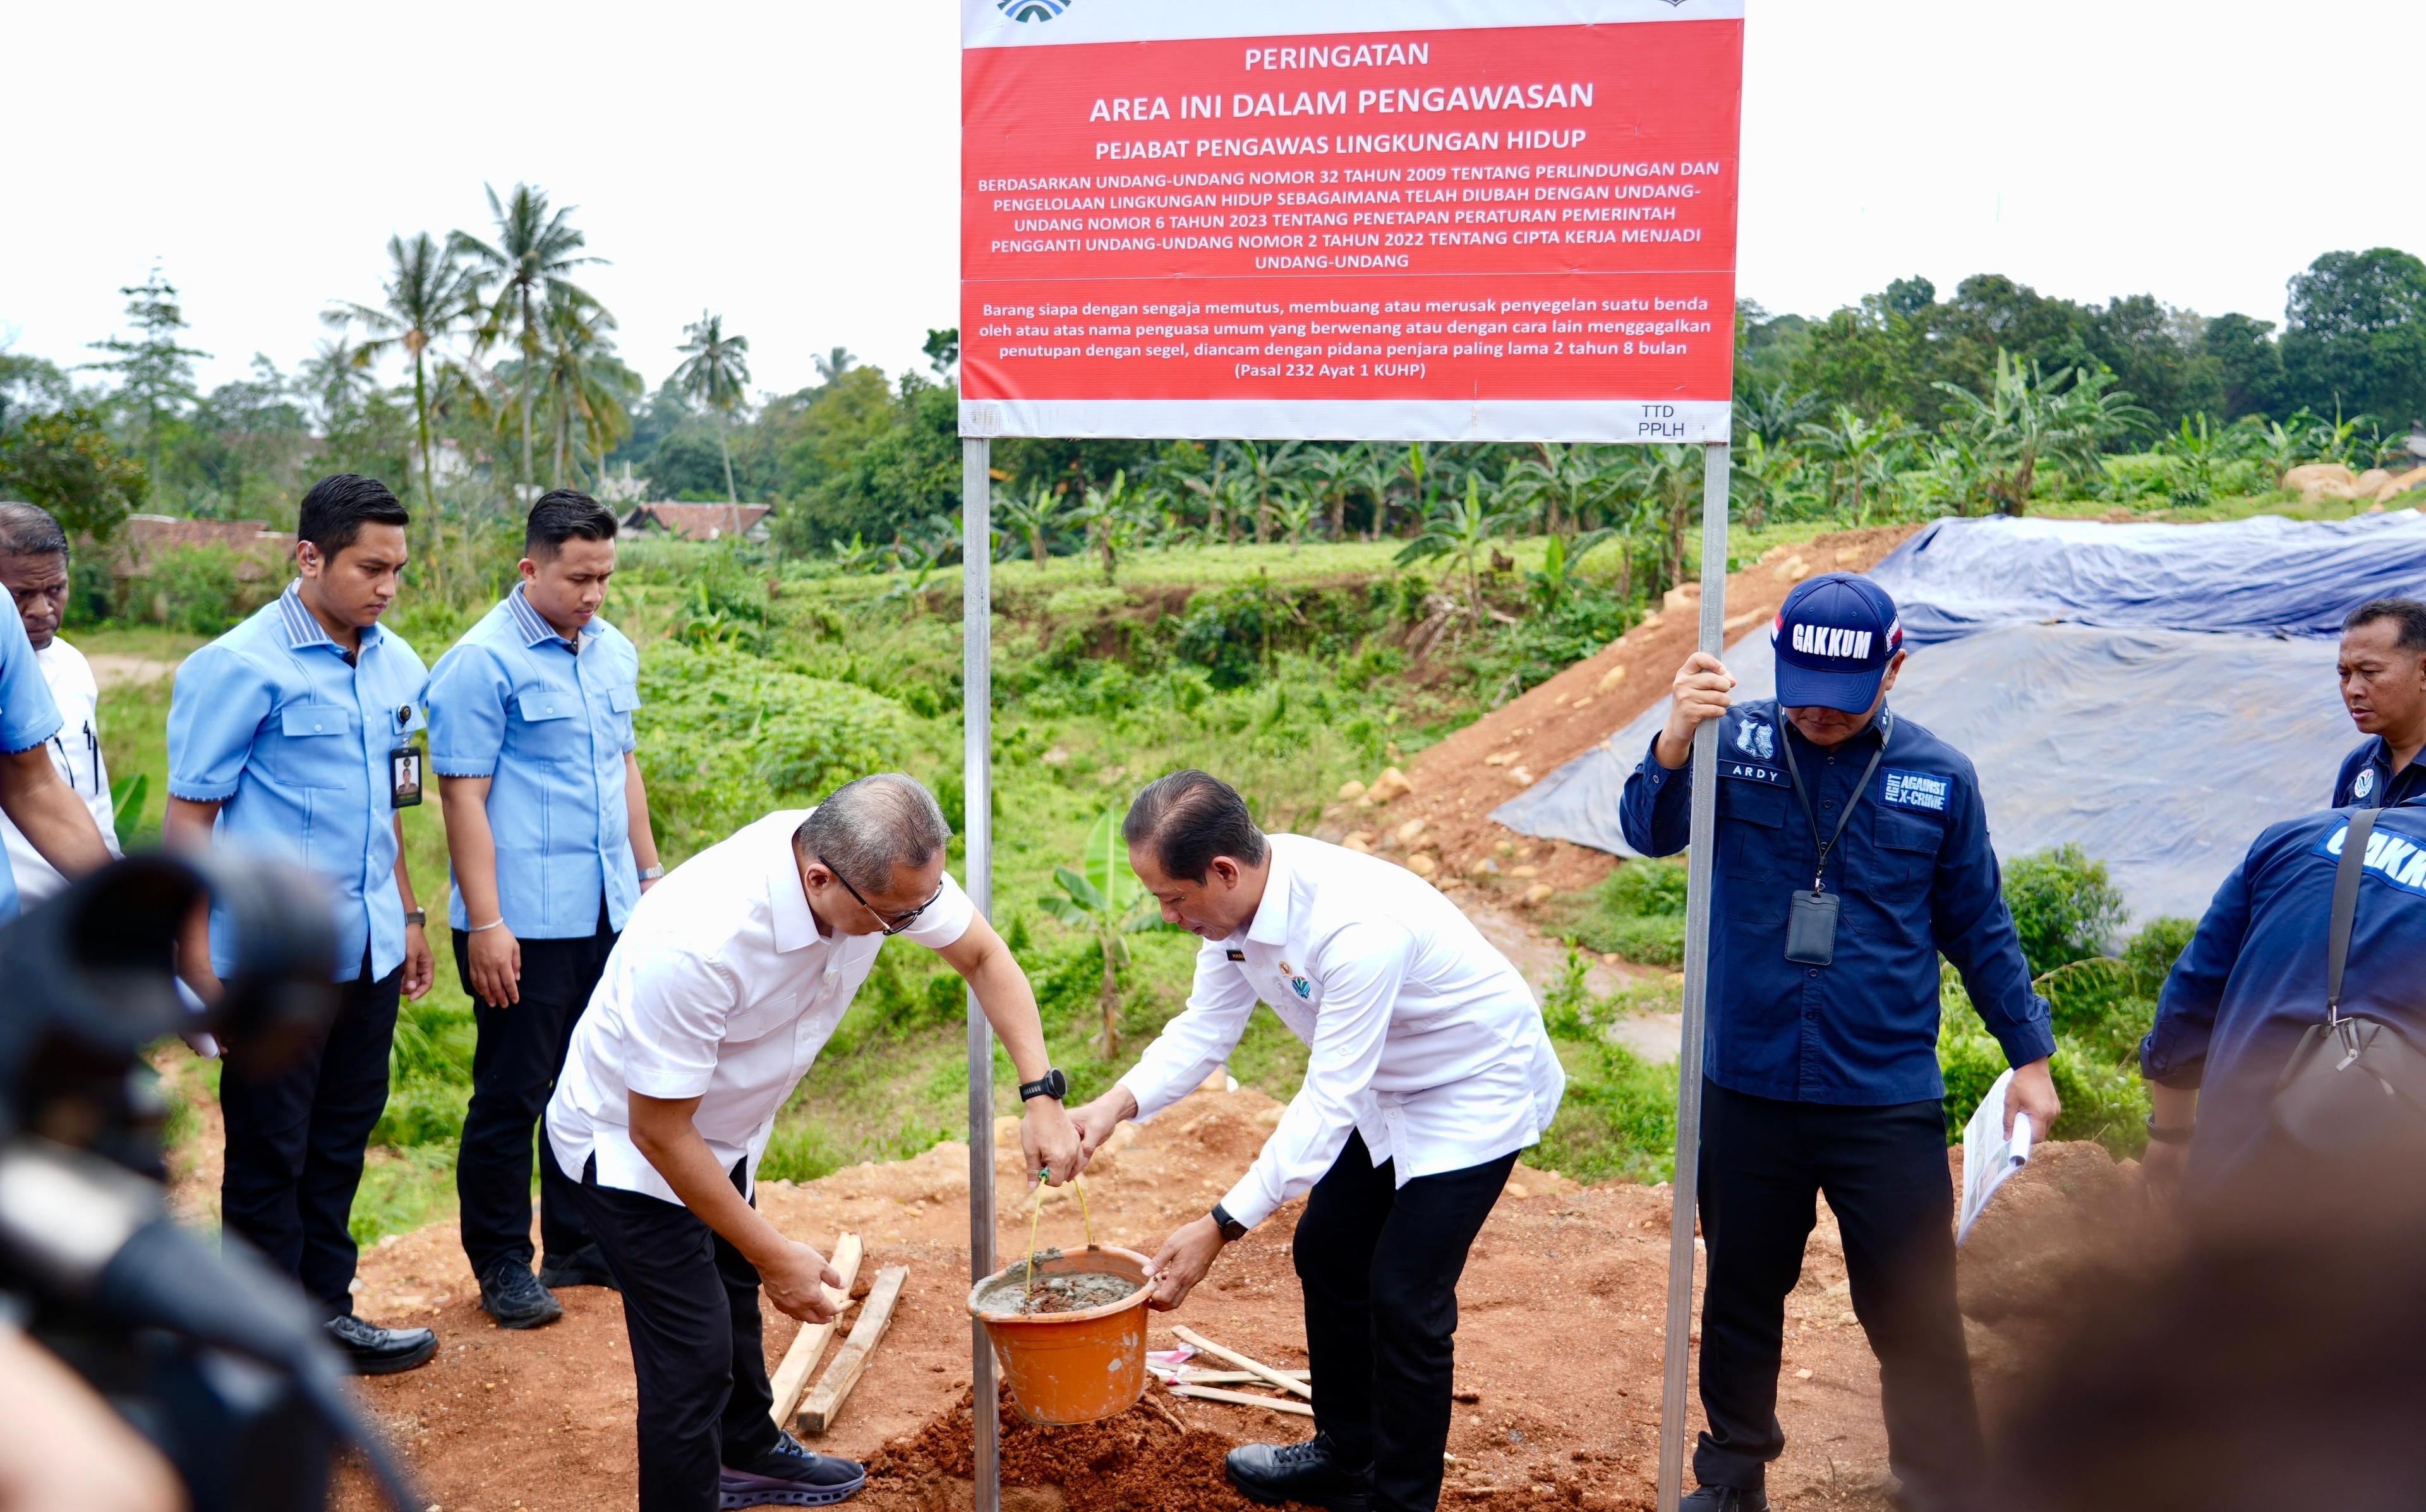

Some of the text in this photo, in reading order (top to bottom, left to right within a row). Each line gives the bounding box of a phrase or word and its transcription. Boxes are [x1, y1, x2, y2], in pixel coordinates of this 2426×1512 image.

[1245, 42, 1428, 71] PERINGATAN
[1089, 83, 1593, 122] AREA INI DALAM PENGAWASAN
[1096, 129, 1586, 160] PEJABAT PENGAWAS LINGKUNGAN HIDUP
[979, 162, 1719, 192] BERDASARKAN UNDANG-UNDANG NOMOR 32 TAHUN 2009 TENTANG PERLINDUNGAN DAN
[994, 184, 1701, 212] PENGELOLAAN LINGKUNGAN HIDUP SEBAGAIMANA TELAH DIUBAH DENGAN UNDANG-
[1015, 207, 1675, 232] UNDANG NOMOR 6 TAHUN 2023 TENTANG PENETAPAN PERATURAN PEMERINTAH
[991, 229, 1701, 253] PENGGANTI UNDANG-UNDANG NOMOR 2 TAHUN 2022 TENTANG CIPTA KERJA MENJADI
[1255, 255, 1409, 269] UNDANG-UNDANG
[983, 296, 1708, 319] Barang siapa dengan sengaja memutus, membuang atau merusak penyegelan suatu benda
[979, 319, 1711, 339] oleh atau atas nama penguasa umum yang berwenang atau dengan cara lain menggagalkan
[999, 341, 1687, 359] penutupan dengan segel, diancam dengan pidana penjara paling lama 2 tahun 8 bulan
[1234, 363, 1425, 380] (Pasal 232 Ayat 1 KUHP)
[1641, 405, 1674, 417] TTD
[1639, 423, 1684, 436] PPLH
[1792, 623, 1872, 659] GAKKUM
[1732, 765, 1778, 782] ARDY
[1885, 773, 1902, 803] FIGHT
[1900, 775, 1946, 796] AGAINST
[1898, 789, 1945, 810] X-CRIME
[2326, 825, 2426, 891] AKK
